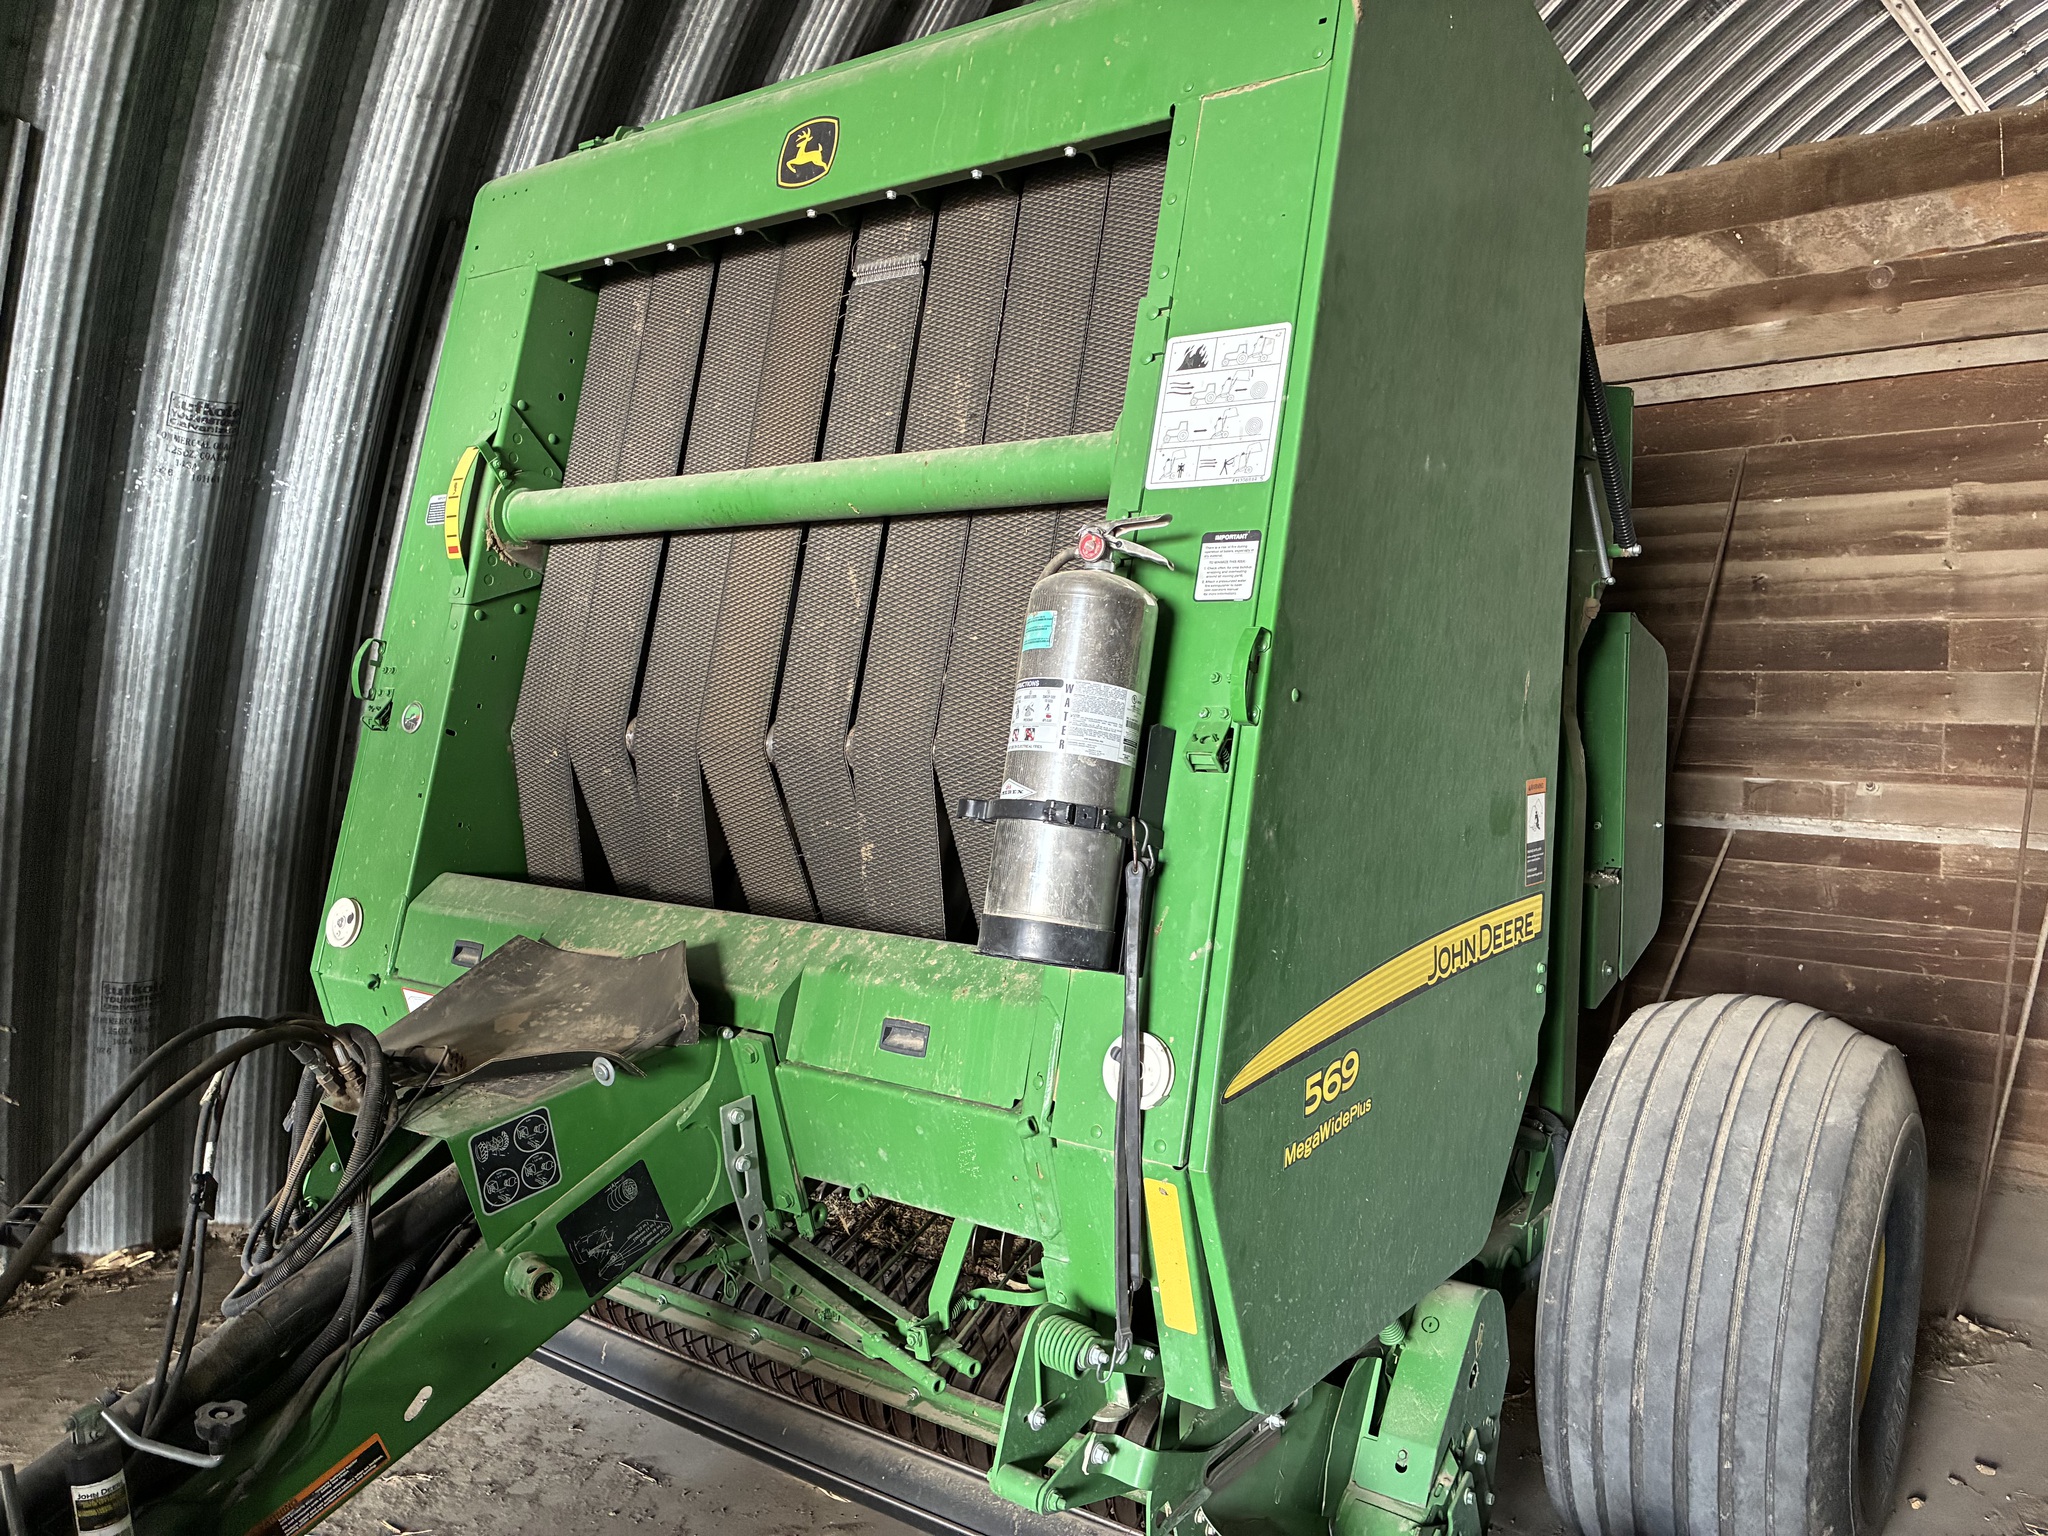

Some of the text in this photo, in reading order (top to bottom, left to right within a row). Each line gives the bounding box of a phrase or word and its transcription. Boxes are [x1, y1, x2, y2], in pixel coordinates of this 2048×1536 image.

[1214, 533, 1248, 541] IMPORTANT
[1428, 911, 1534, 982] JOHN DEERE
[1304, 1050, 1360, 1117] 569
[1283, 1097, 1373, 1169] MegaWidePlus
[77, 1491, 99, 1500] JOHN
